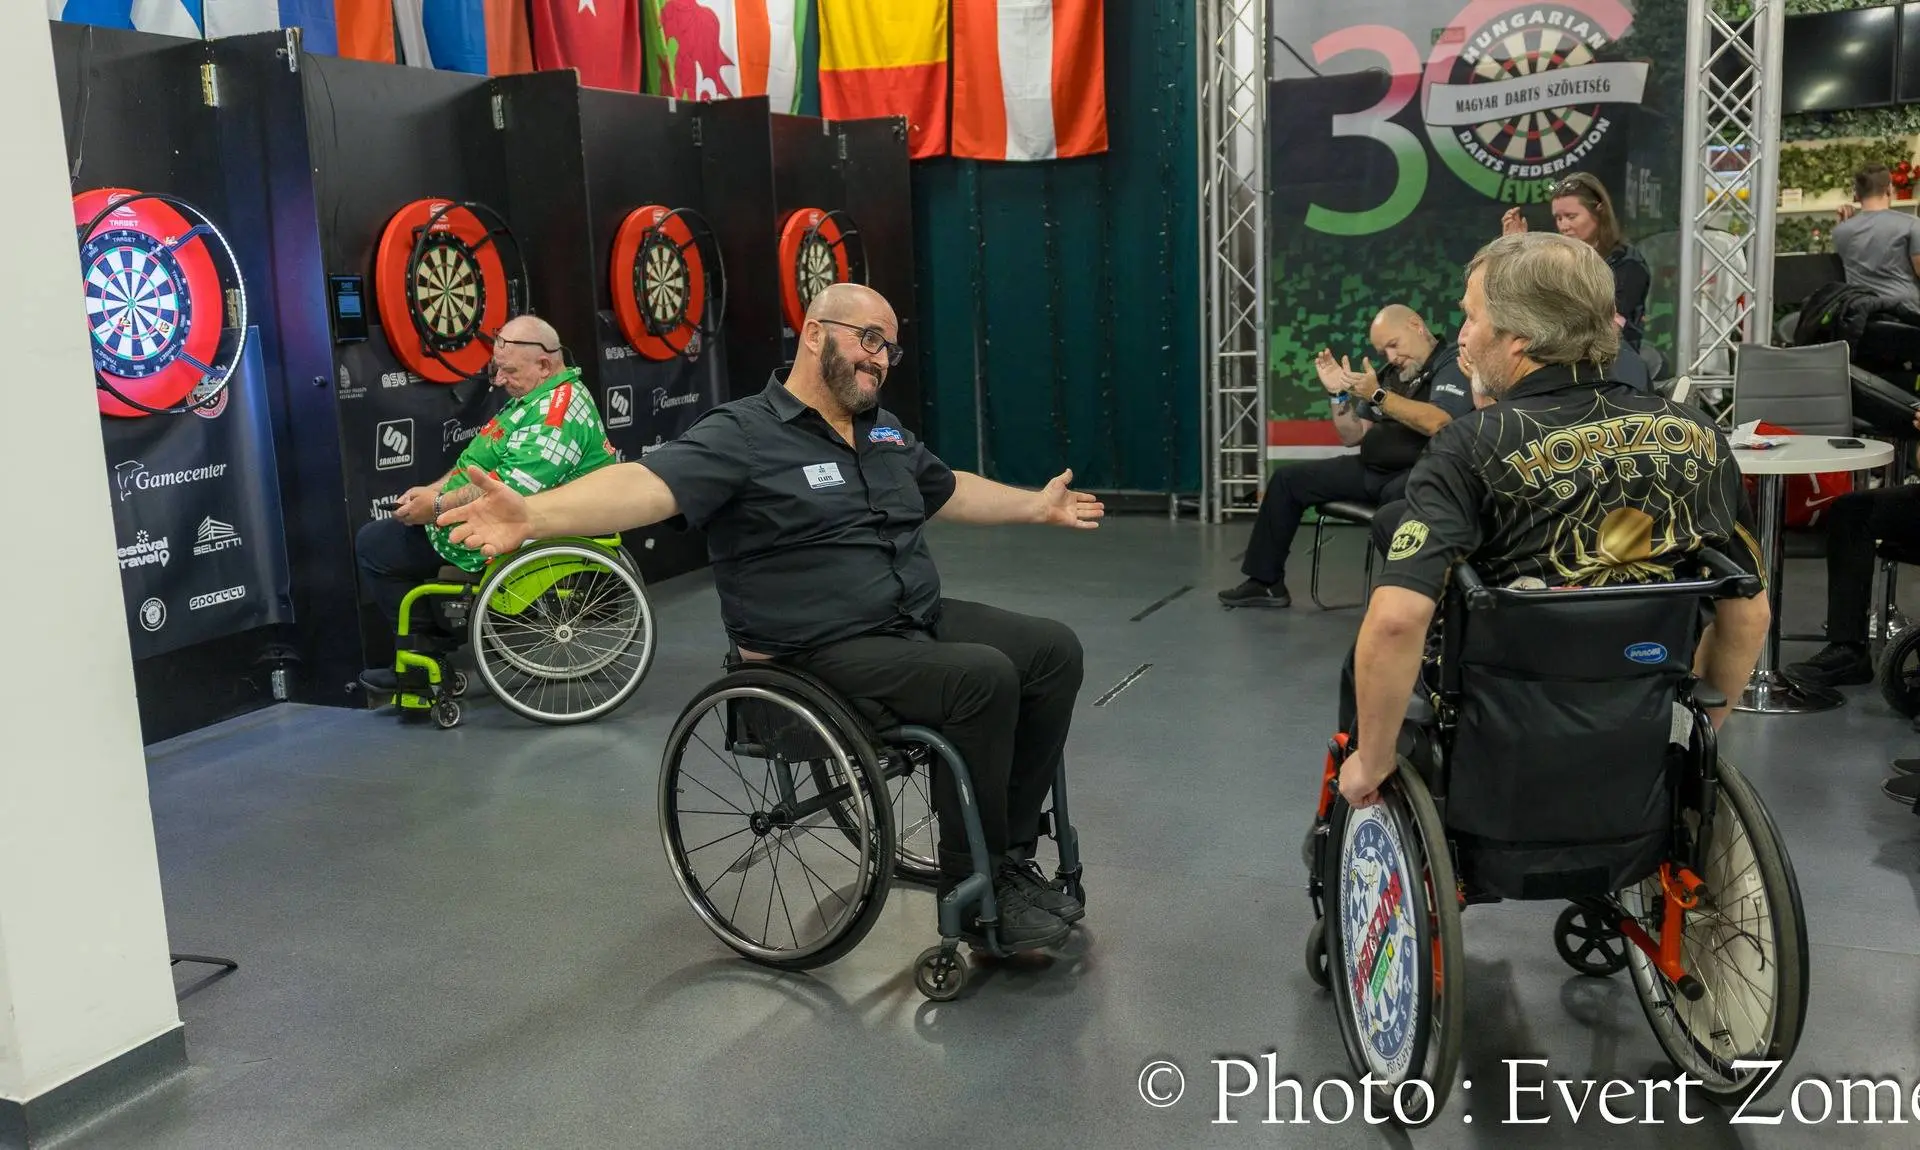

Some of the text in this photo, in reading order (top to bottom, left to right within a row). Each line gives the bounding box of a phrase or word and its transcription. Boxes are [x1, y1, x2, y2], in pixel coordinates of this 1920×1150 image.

[1462, 9, 1606, 65] HUNGARIAN
[1456, 76, 1611, 113] MAGYAR DARTS SZÖVETSÉG
[1458, 116, 1611, 177] DARTS FEDERATION
[109, 219, 139, 227] TARGET
[1501, 414, 1718, 489] HORIZON
[135, 463, 227, 490] Gamecenter
[1548, 454, 1699, 500] DARTS
[118, 537, 169, 558] estival
[119, 552, 159, 569] ravel
[193, 537, 243, 556] BELOTTI
